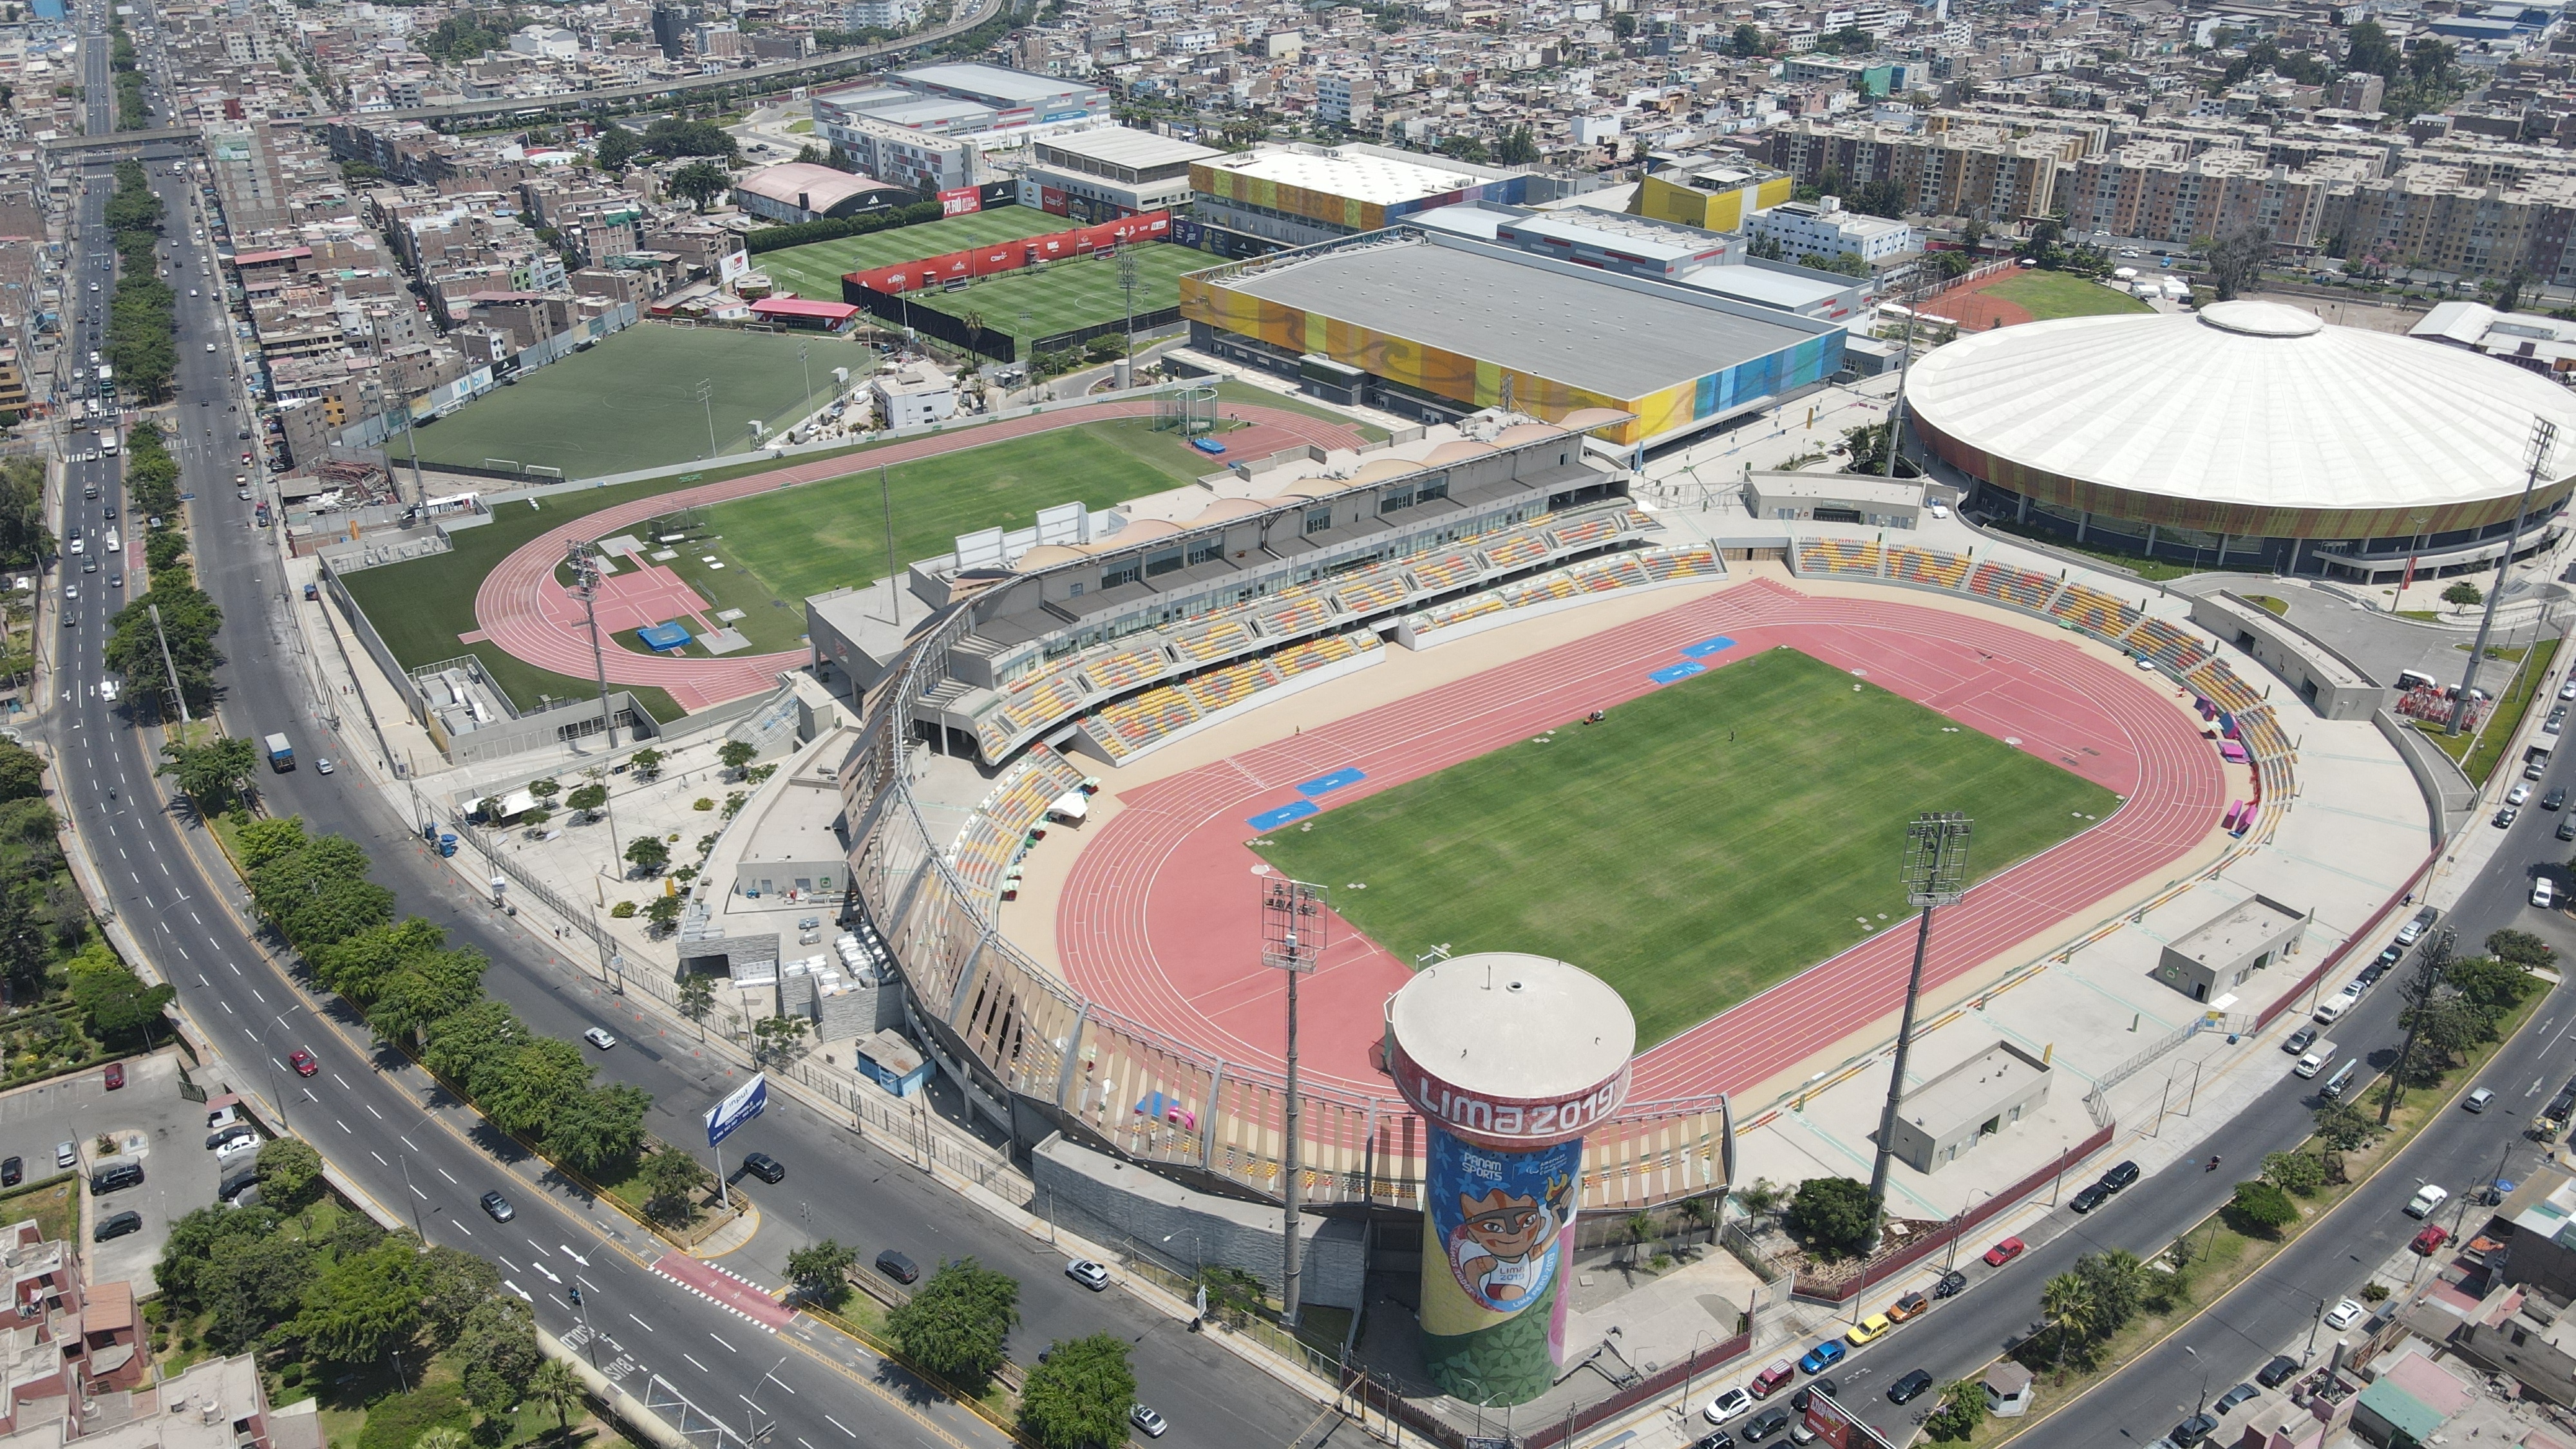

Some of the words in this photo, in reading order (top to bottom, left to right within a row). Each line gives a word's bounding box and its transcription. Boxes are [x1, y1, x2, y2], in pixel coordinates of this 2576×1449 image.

[943, 196, 961, 214] PERÚ
[459, 373, 484, 393] Mbil
[1530, 1082, 1616, 1135] 2019
[1464, 1151, 1502, 1171] PANAM
[1462, 1162, 1502, 1182] SPORTS
[1454, 1269, 1474, 1294] TODOS
[1513, 1296, 1532, 1307] LIMA
[560, 1324, 596, 1351] SOLO
[603, 1357, 636, 1381] BUS
